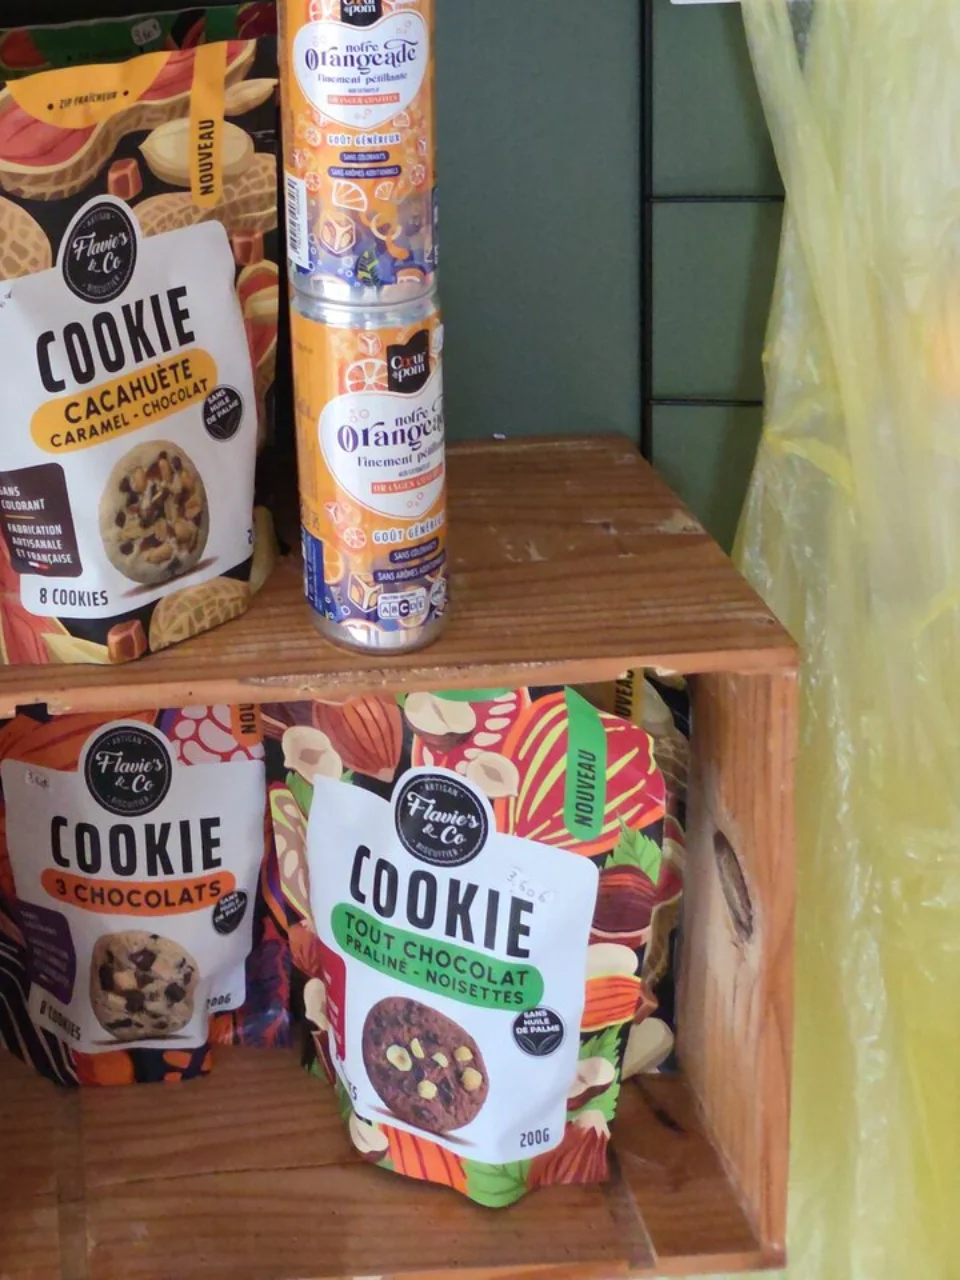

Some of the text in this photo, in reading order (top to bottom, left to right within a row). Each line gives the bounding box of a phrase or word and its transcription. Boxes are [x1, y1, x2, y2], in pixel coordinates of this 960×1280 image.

[305, 38, 419, 75] Orangeade
[345, 40, 380, 53] notre
[58, 97, 72, 110] ZIP
[328, 133, 351, 145] GOÛT
[199, 118, 215, 197] NOUVEAU
[72, 231, 129, 262] Flavie's
[102, 251, 121, 274] Co
[36, 285, 195, 393] COOKIE
[64, 358, 193, 424] CACAHUÈTE
[206, 389, 227, 406] SANS
[50, 378, 210, 448] CARAMEL CHOCOLAT
[394, 407, 429, 427] notre
[1, 498, 45, 511] COLORANT
[7, 523, 62, 535] FABRICATION
[373, 528, 403, 542] GOÛT
[12, 536, 62, 550] ARTISANALE
[16, 548, 73, 565] ET FRANÇAISE
[39, 587, 109, 607] 8 COOKIES
[95, 749, 165, 774] Flavie's
[131, 774, 156, 793] Co
[423, 782, 459, 799] ARTISAN
[574, 749, 596, 828] NOUVEAU
[406, 789, 480, 829] Flavie's
[440, 823, 467, 846] Co
[50, 815, 222, 877] COOKIE
[55, 878, 222, 909] 3 CHOCOLATS
[349, 844, 535, 959] COOKIE
[344, 911, 530, 987] TOUT CHOCOLAT
[346, 934, 525, 1006] PRALINÉ NOISETTES
[48, 1007, 82, 1041] COOKIES
[523, 1010, 548, 1019] SANS
[523, 1017, 551, 1026] HUILE
[515, 1023, 560, 1034] DE PALME
[519, 1131, 551, 1148] 200G
